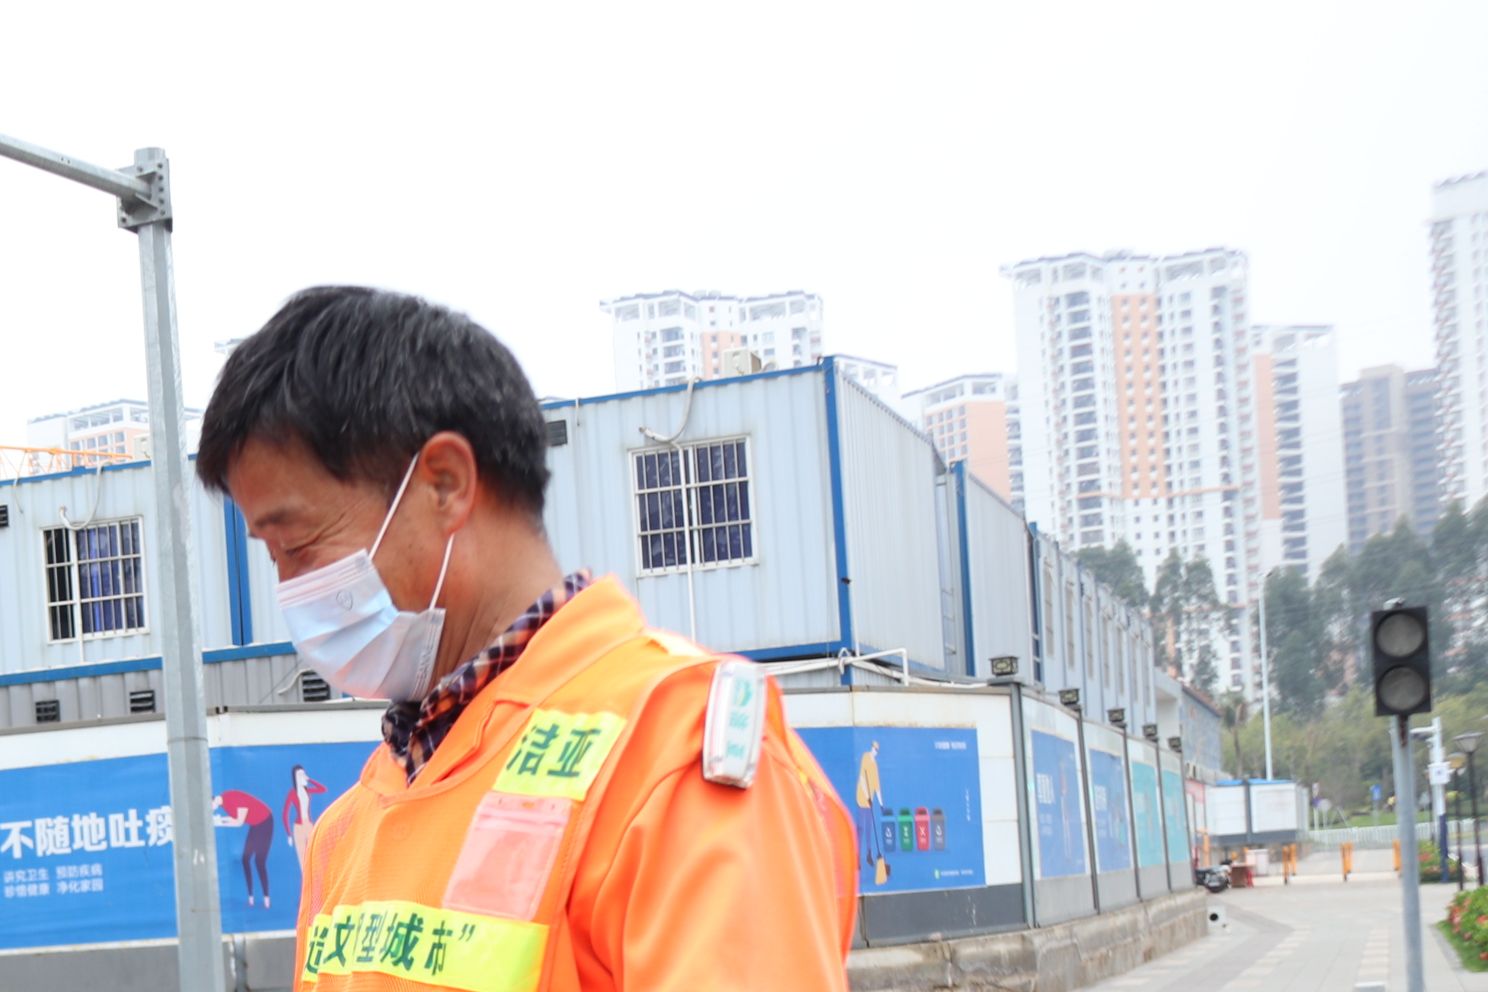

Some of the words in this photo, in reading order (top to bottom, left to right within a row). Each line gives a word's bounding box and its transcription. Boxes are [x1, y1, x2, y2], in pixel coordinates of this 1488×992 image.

[0, 805, 174, 859] 不随地吐痰
[3, 868, 49, 884] 讲究卫生
[56, 863, 103, 880] 预防疾病
[57, 878, 104, 895] 净化家园
